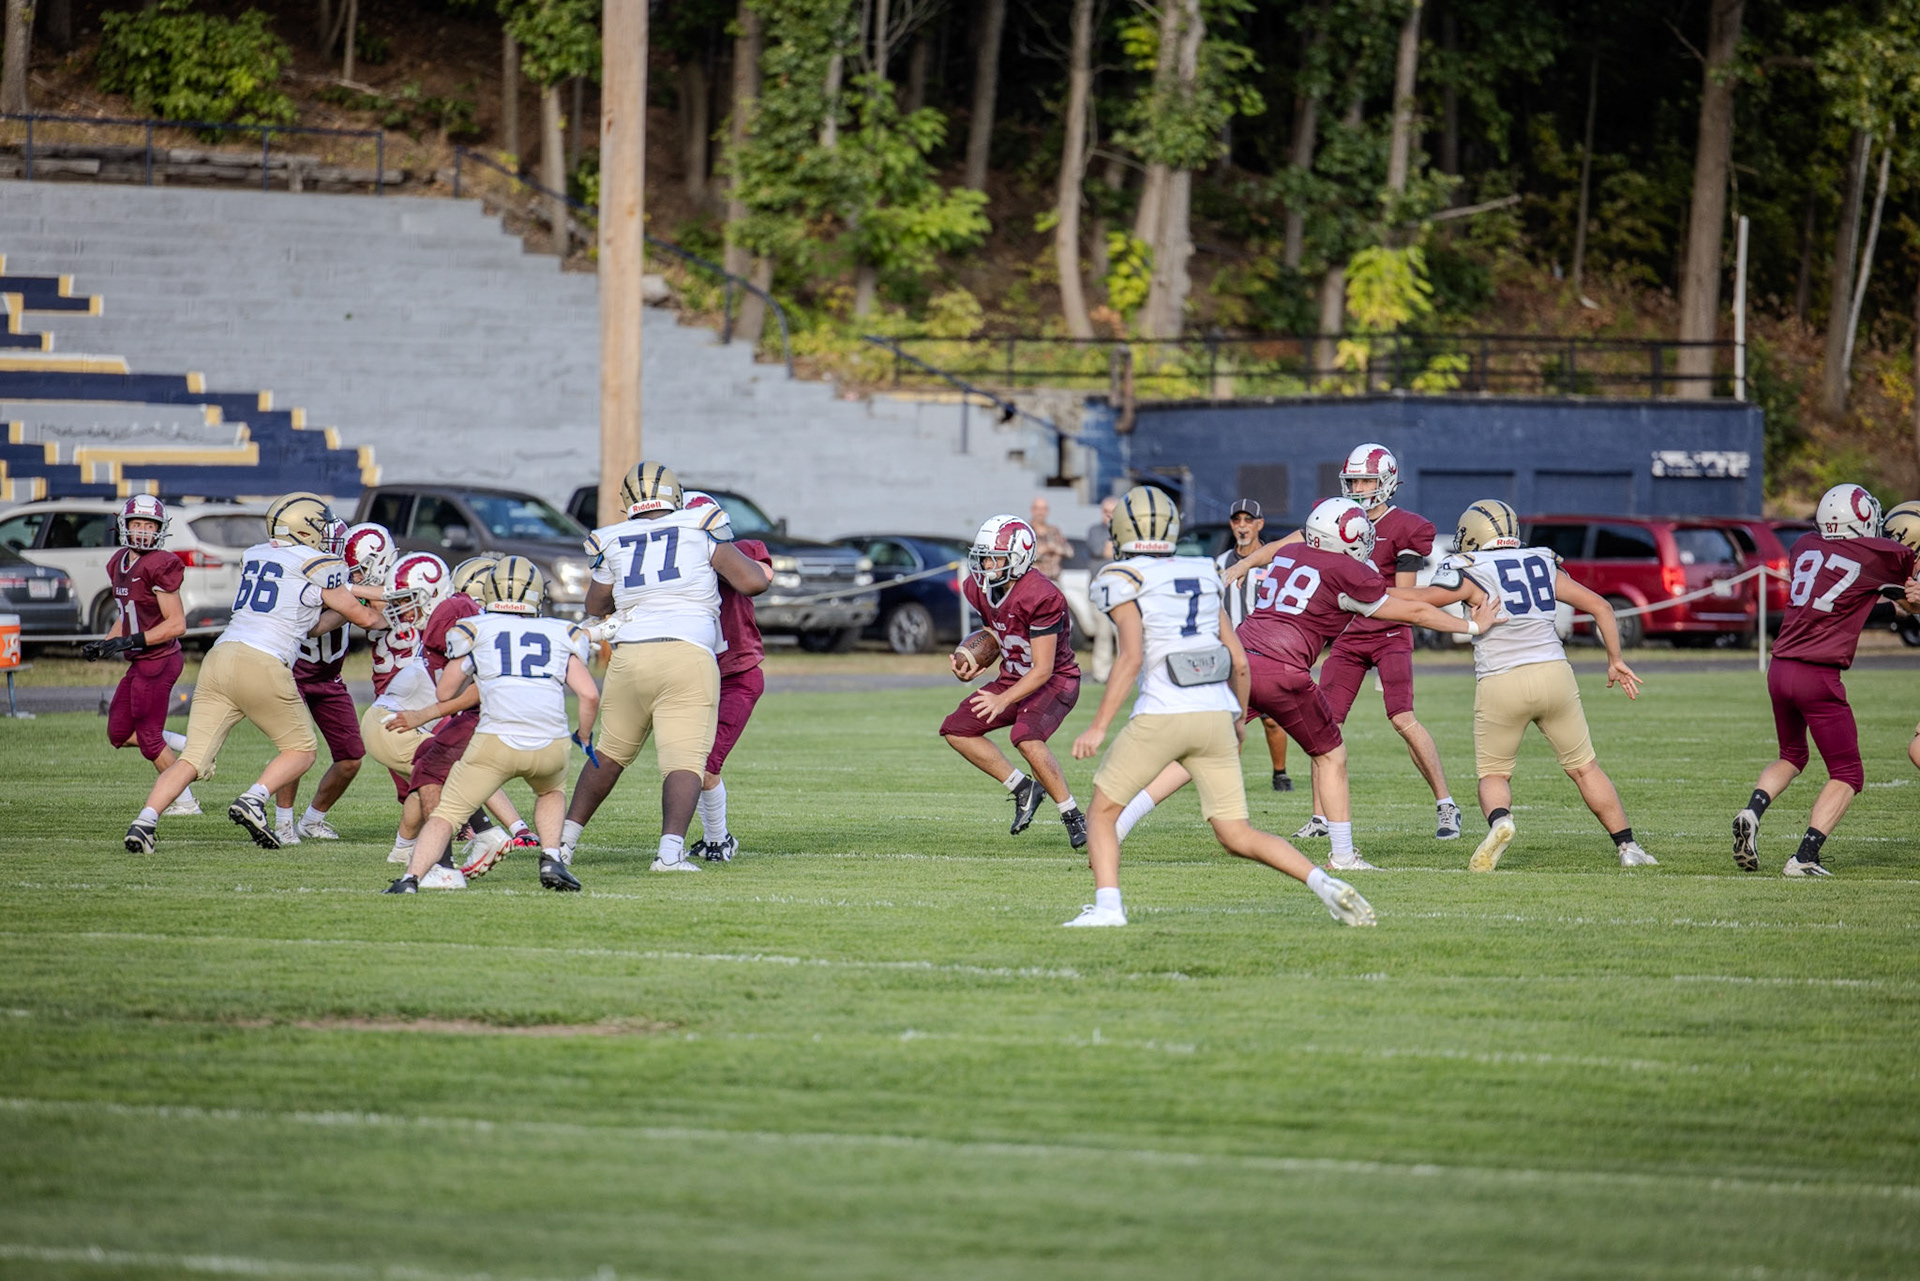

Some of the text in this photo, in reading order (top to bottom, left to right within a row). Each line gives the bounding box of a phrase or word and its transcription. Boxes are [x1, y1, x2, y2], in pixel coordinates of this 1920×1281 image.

[632, 501, 662, 513] Riddell
[1825, 522, 1838, 533] 87
[618, 526, 681, 588] 77
[1134, 542, 1169, 550] Riddell
[233, 559, 283, 613] 66
[327, 572, 342, 589] 66
[1101, 586, 1110, 606] 7
[1256, 555, 1321, 615] 58
[1494, 555, 1556, 615] 58
[1790, 550, 1861, 613] 87
[494, 603, 526, 611] Riddell
[1174, 578, 1202, 637] 7
[494, 631, 552, 678] 12
